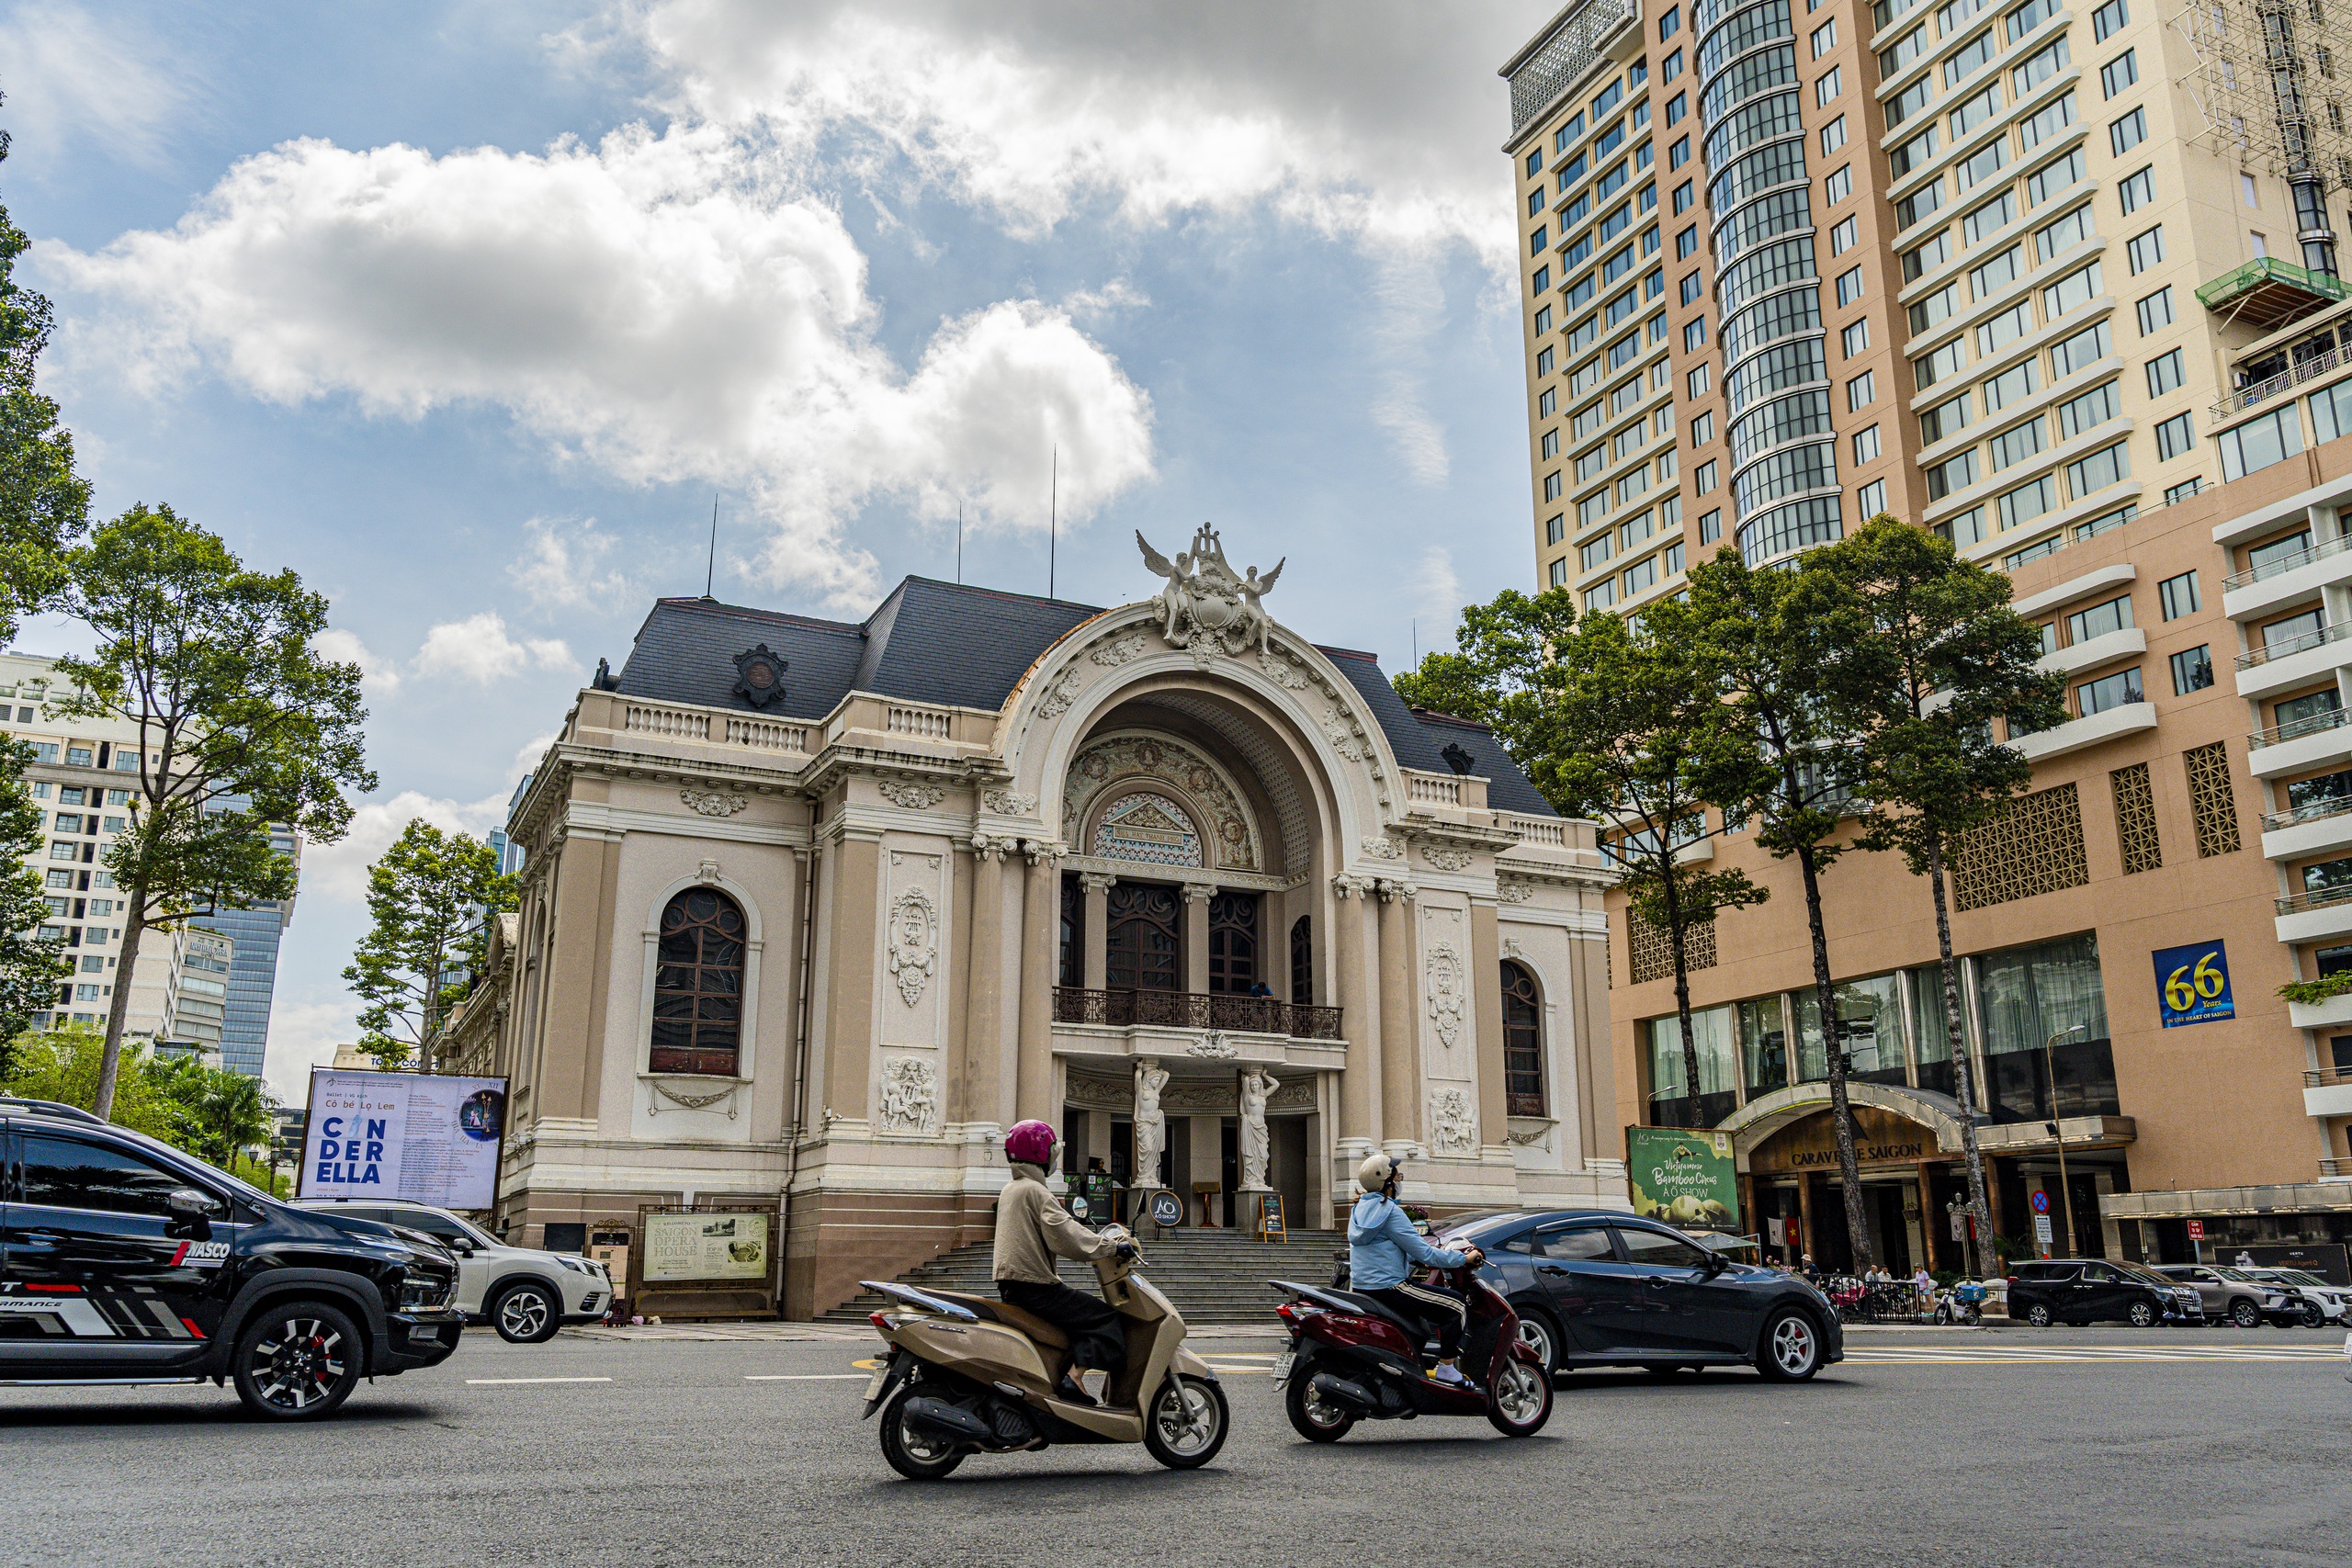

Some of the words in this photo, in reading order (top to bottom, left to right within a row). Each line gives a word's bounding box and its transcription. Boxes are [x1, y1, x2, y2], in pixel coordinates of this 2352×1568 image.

[2165, 952, 2224, 1011] 66
[360, 1102, 371, 1111] Lọ
[320, 1140, 383, 1161] DER
[1792, 1148, 1865, 1166] CARAVEE
[1869, 1144, 1922, 1159] SAIGON
[316, 1162, 379, 1183] ELLA
[1664, 1157, 1702, 1173] Vietnamese
[1652, 1168, 1694, 1185] Bamboo
[1696, 1172, 1717, 1185] Circus
[1680, 1188, 1708, 1197] SHOW
[655, 1227, 696, 1235] SAIGON
[655, 1236, 696, 1246] OPERA
[654, 1247, 697, 1257] HOUSE
